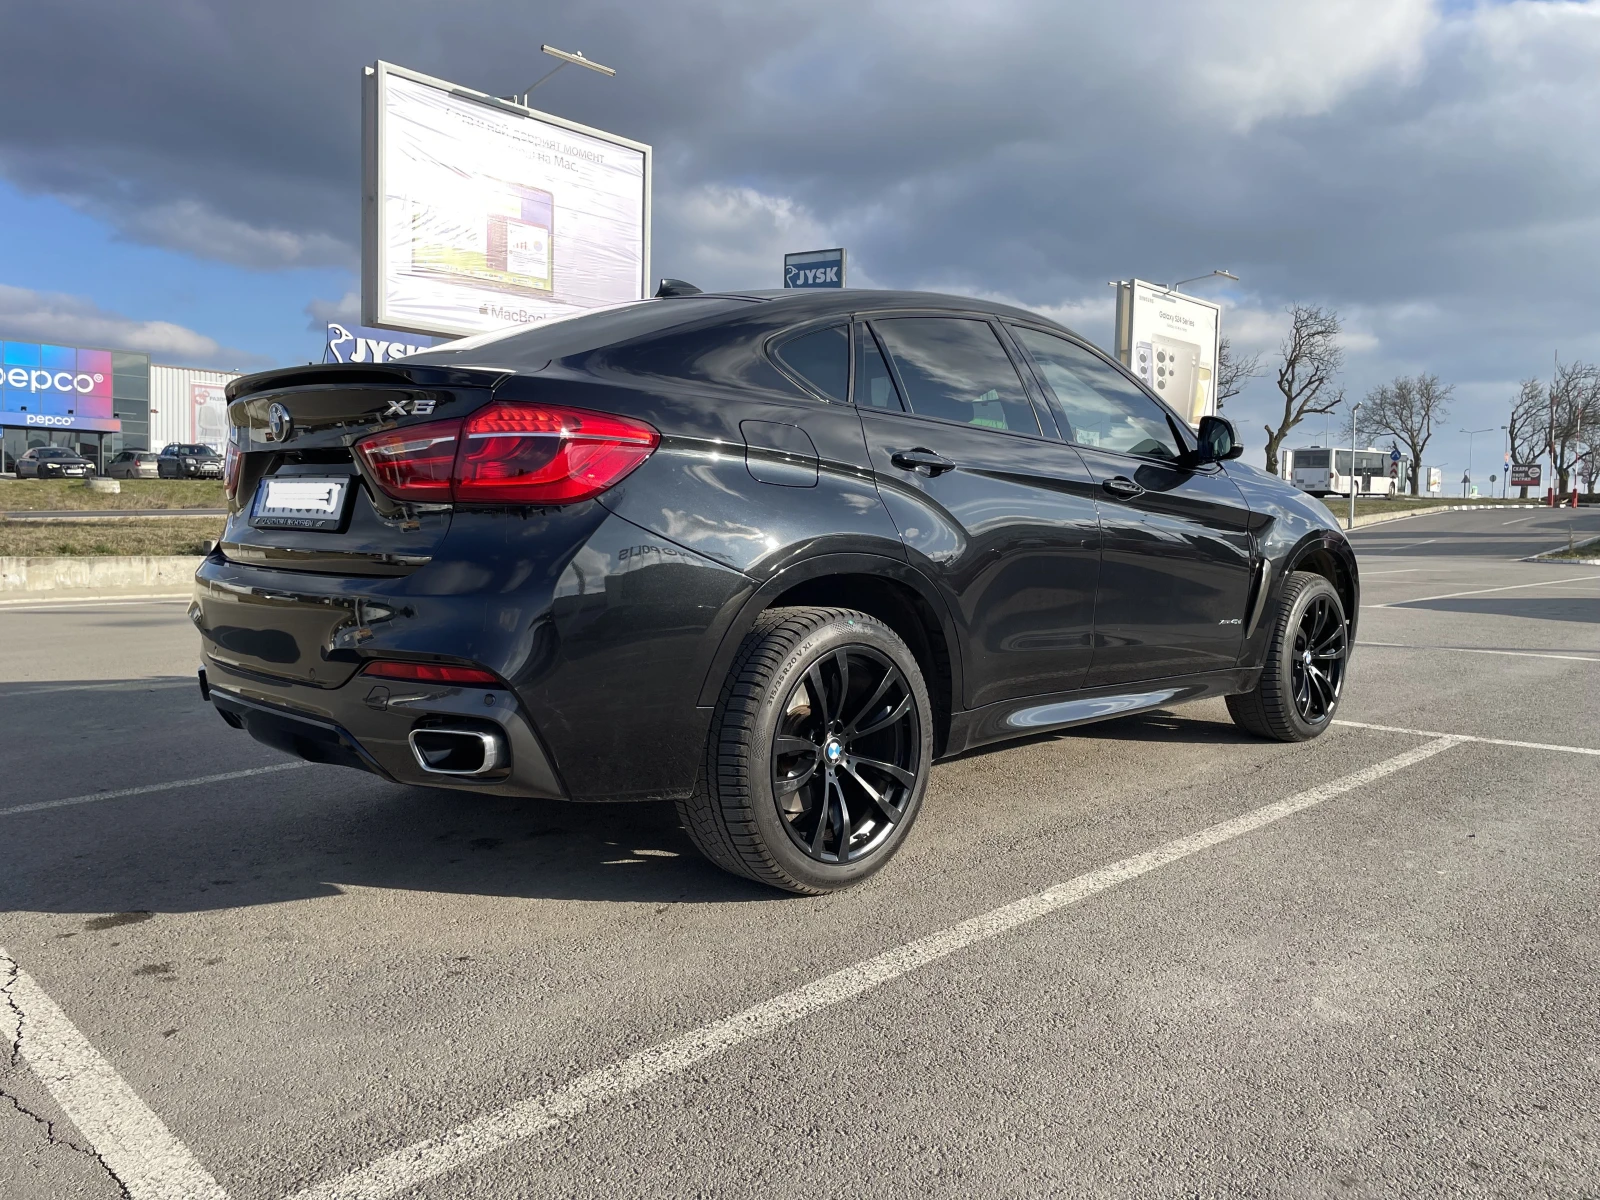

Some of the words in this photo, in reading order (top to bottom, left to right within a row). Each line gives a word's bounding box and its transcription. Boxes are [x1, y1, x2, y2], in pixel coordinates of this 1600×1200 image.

[796, 266, 839, 285] JYSK
[1159, 311, 1174, 323] Galaxy
[1182, 317, 1194, 327] Series
[383, 400, 437, 415] X6
[26, 414, 71, 426] pepco
[767, 675, 785, 706] 315/35
[782, 657, 797, 675] R20
[796, 649, 803, 657] V
[802, 641, 814, 651] XL
